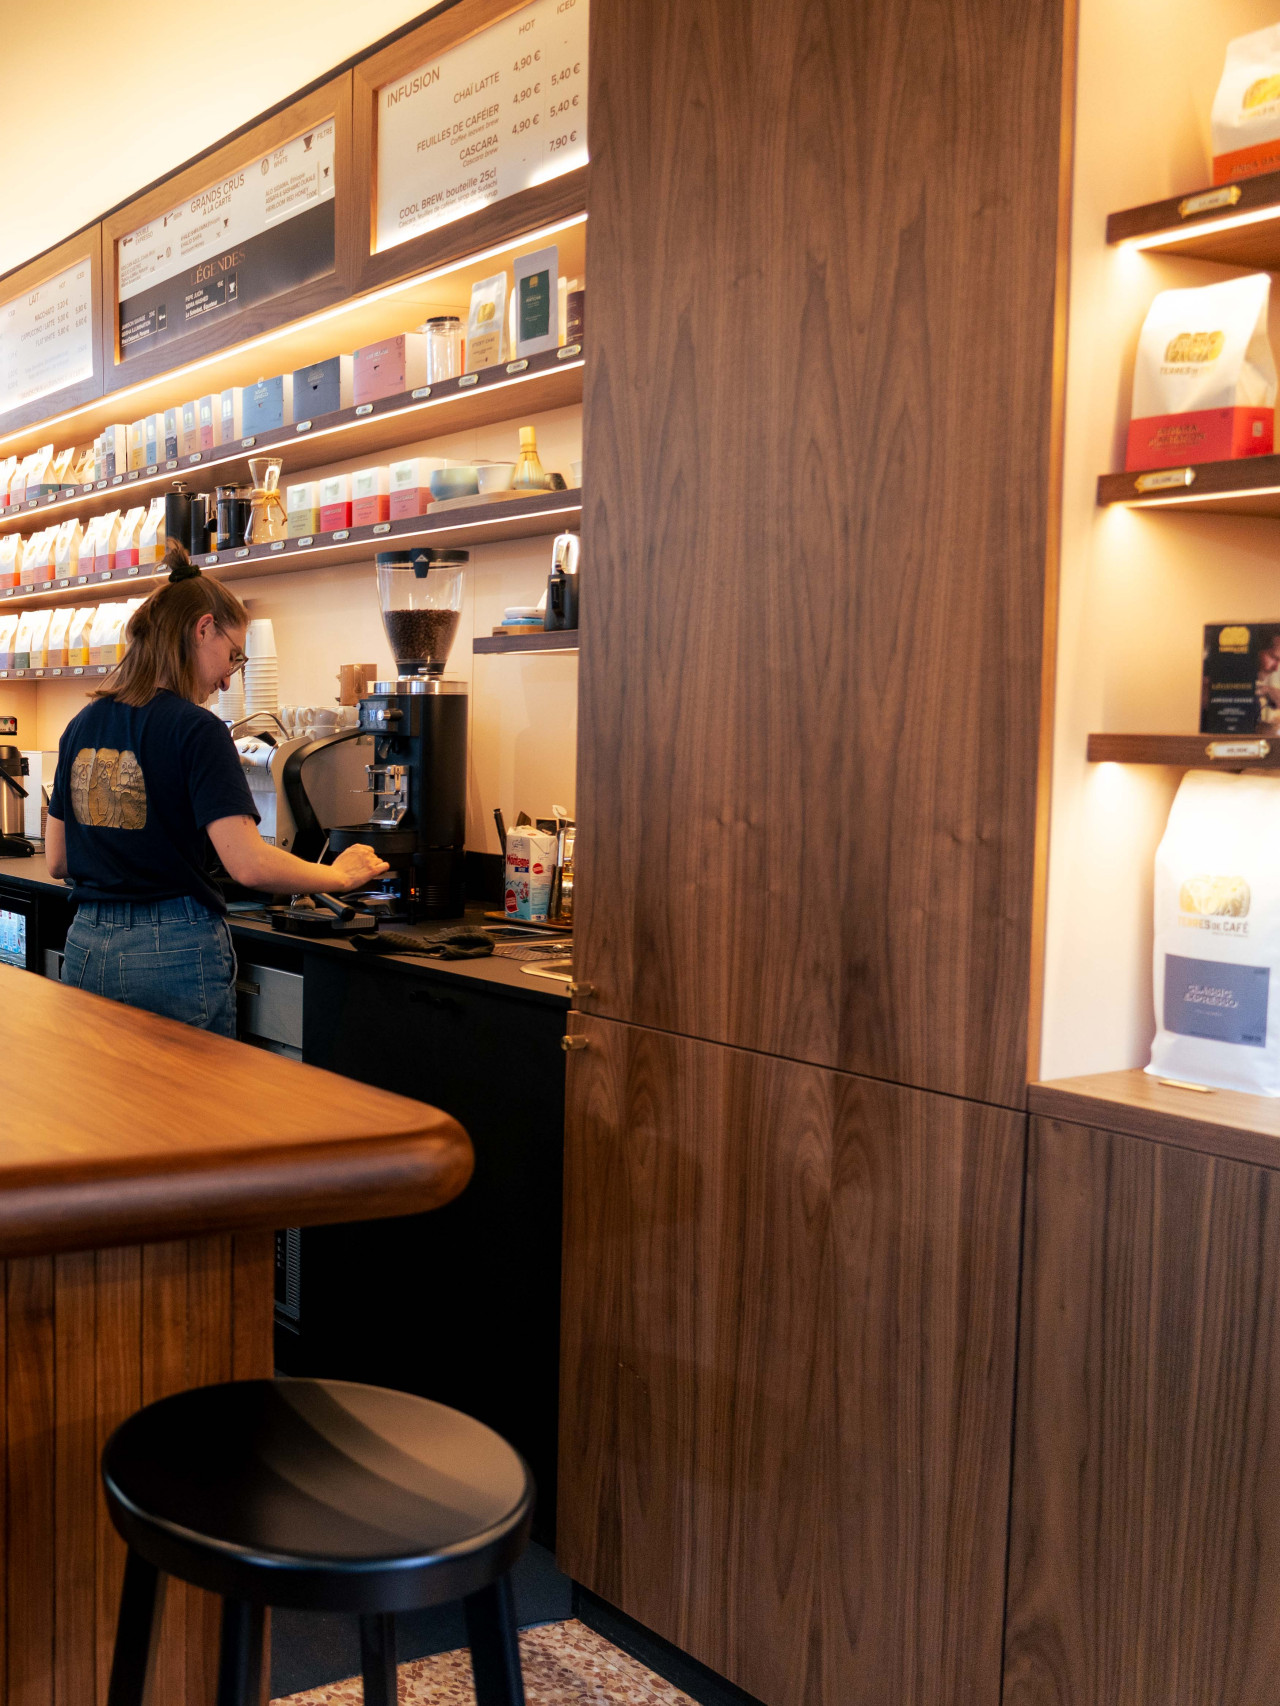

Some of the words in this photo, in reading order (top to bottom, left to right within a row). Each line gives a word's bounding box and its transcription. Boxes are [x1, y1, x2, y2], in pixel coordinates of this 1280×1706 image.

[518, 19, 536, 36] HOT
[556, 0, 578, 15] ICED
[387, 66, 441, 108] INFUSION
[474, 72, 500, 94] LATTE
[512, 54, 532, 72] 4,90
[416, 127, 452, 153] FEUILLES
[452, 120, 464, 135] DE
[465, 104, 500, 129] CAFÉIER
[512, 86, 532, 104] 4,90
[551, 67, 571, 86] 5,40
[316, 126, 334, 142] FILTRE
[450, 133, 467, 147] Coffee
[468, 125, 485, 140] leaves
[485, 118, 499, 132] brew
[459, 134, 499, 161] CASCARA
[511, 118, 531, 135] 4,90
[549, 99, 570, 118] 5,40
[273, 149, 285, 162] FLAT
[273, 155, 289, 169] WHITE
[462, 151, 484, 168] Cascara
[484, 146, 499, 161] brew
[190, 188, 222, 214] GRANDS
[223, 173, 245, 197] CRUS
[399, 203, 420, 220] COOL
[445, 176, 478, 200] bouteille
[479, 167, 497, 185] 25cl
[549, 135, 568, 152] 7,90
[215, 194, 232, 211] CARTE
[190, 249, 246, 286] LÉGENDES
[28, 292, 40, 307] LAIT
[1177, 914, 1211, 931] TERRES
[1222, 919, 1249, 935] CAFÉ
